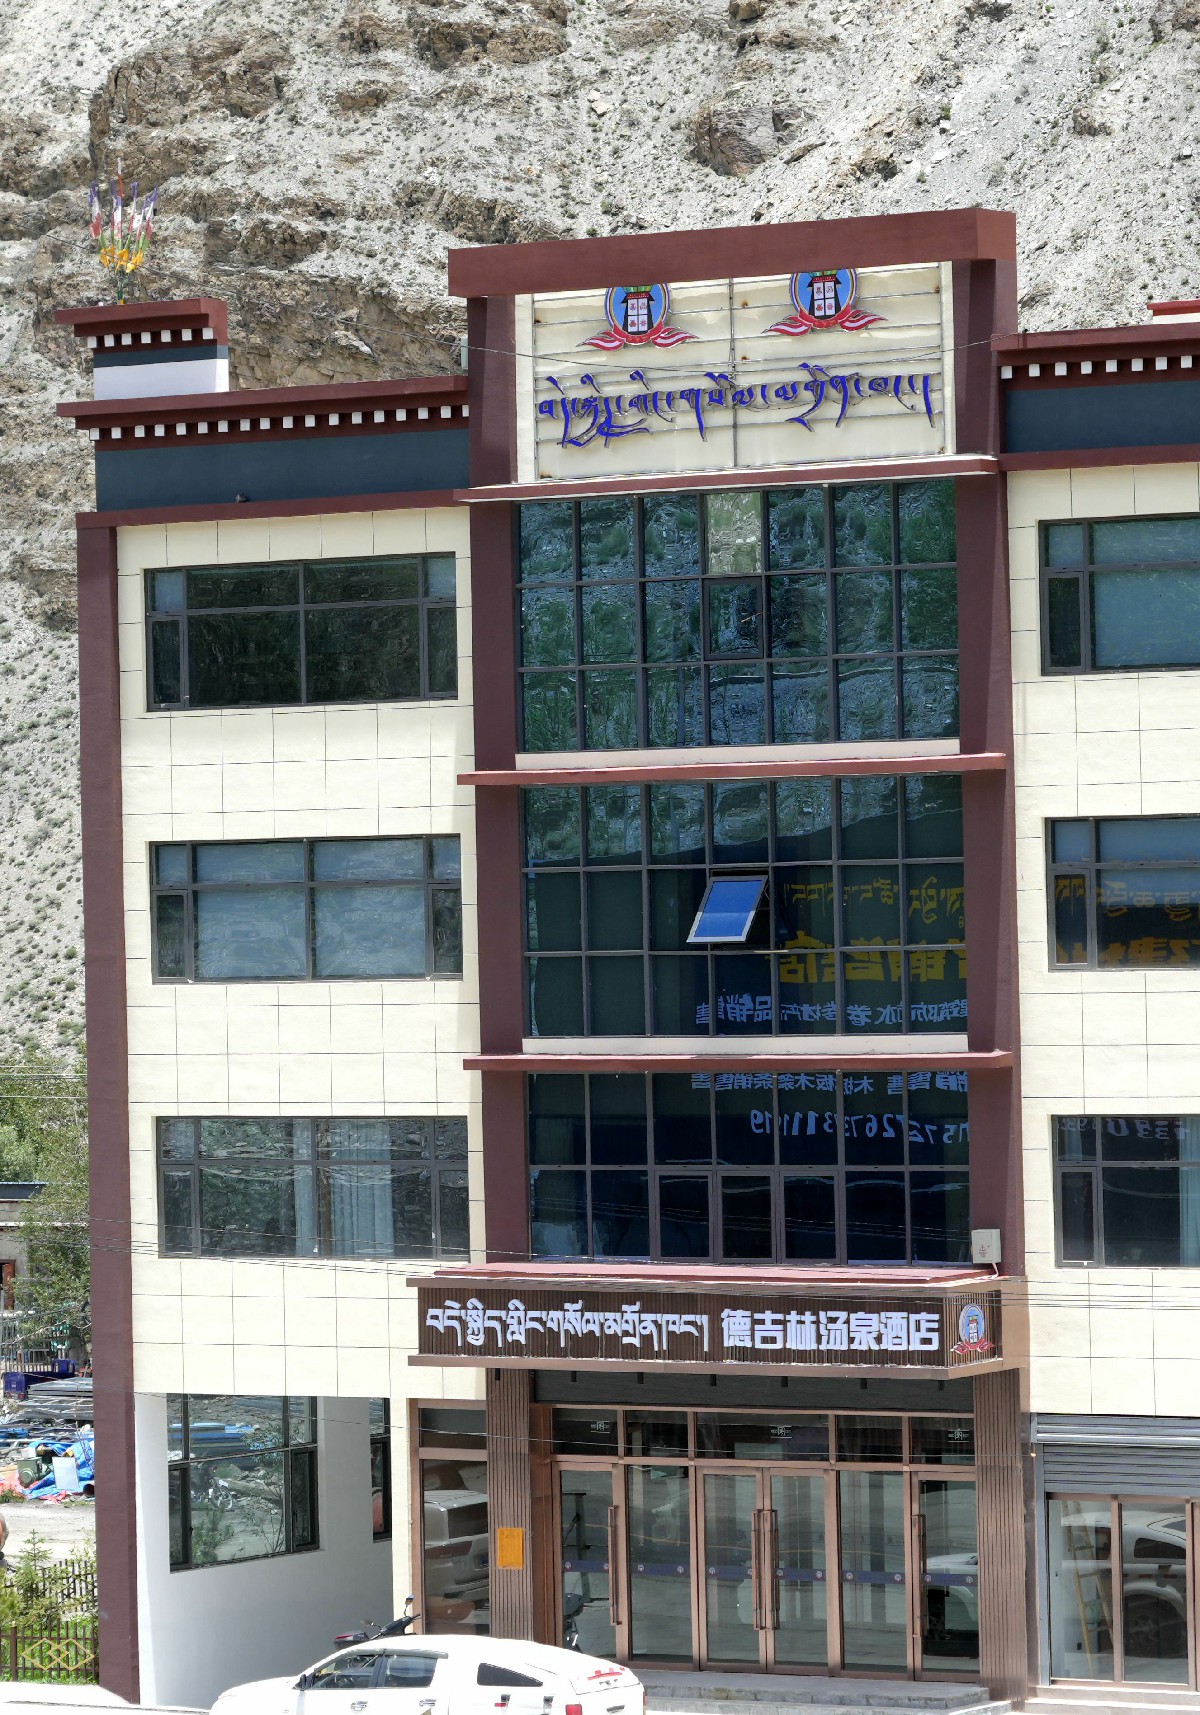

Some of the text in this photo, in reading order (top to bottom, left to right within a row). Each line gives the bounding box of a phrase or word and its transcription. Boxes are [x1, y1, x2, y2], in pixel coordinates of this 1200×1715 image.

[721, 1308, 940, 1352] 德吉林汤泉酒店
